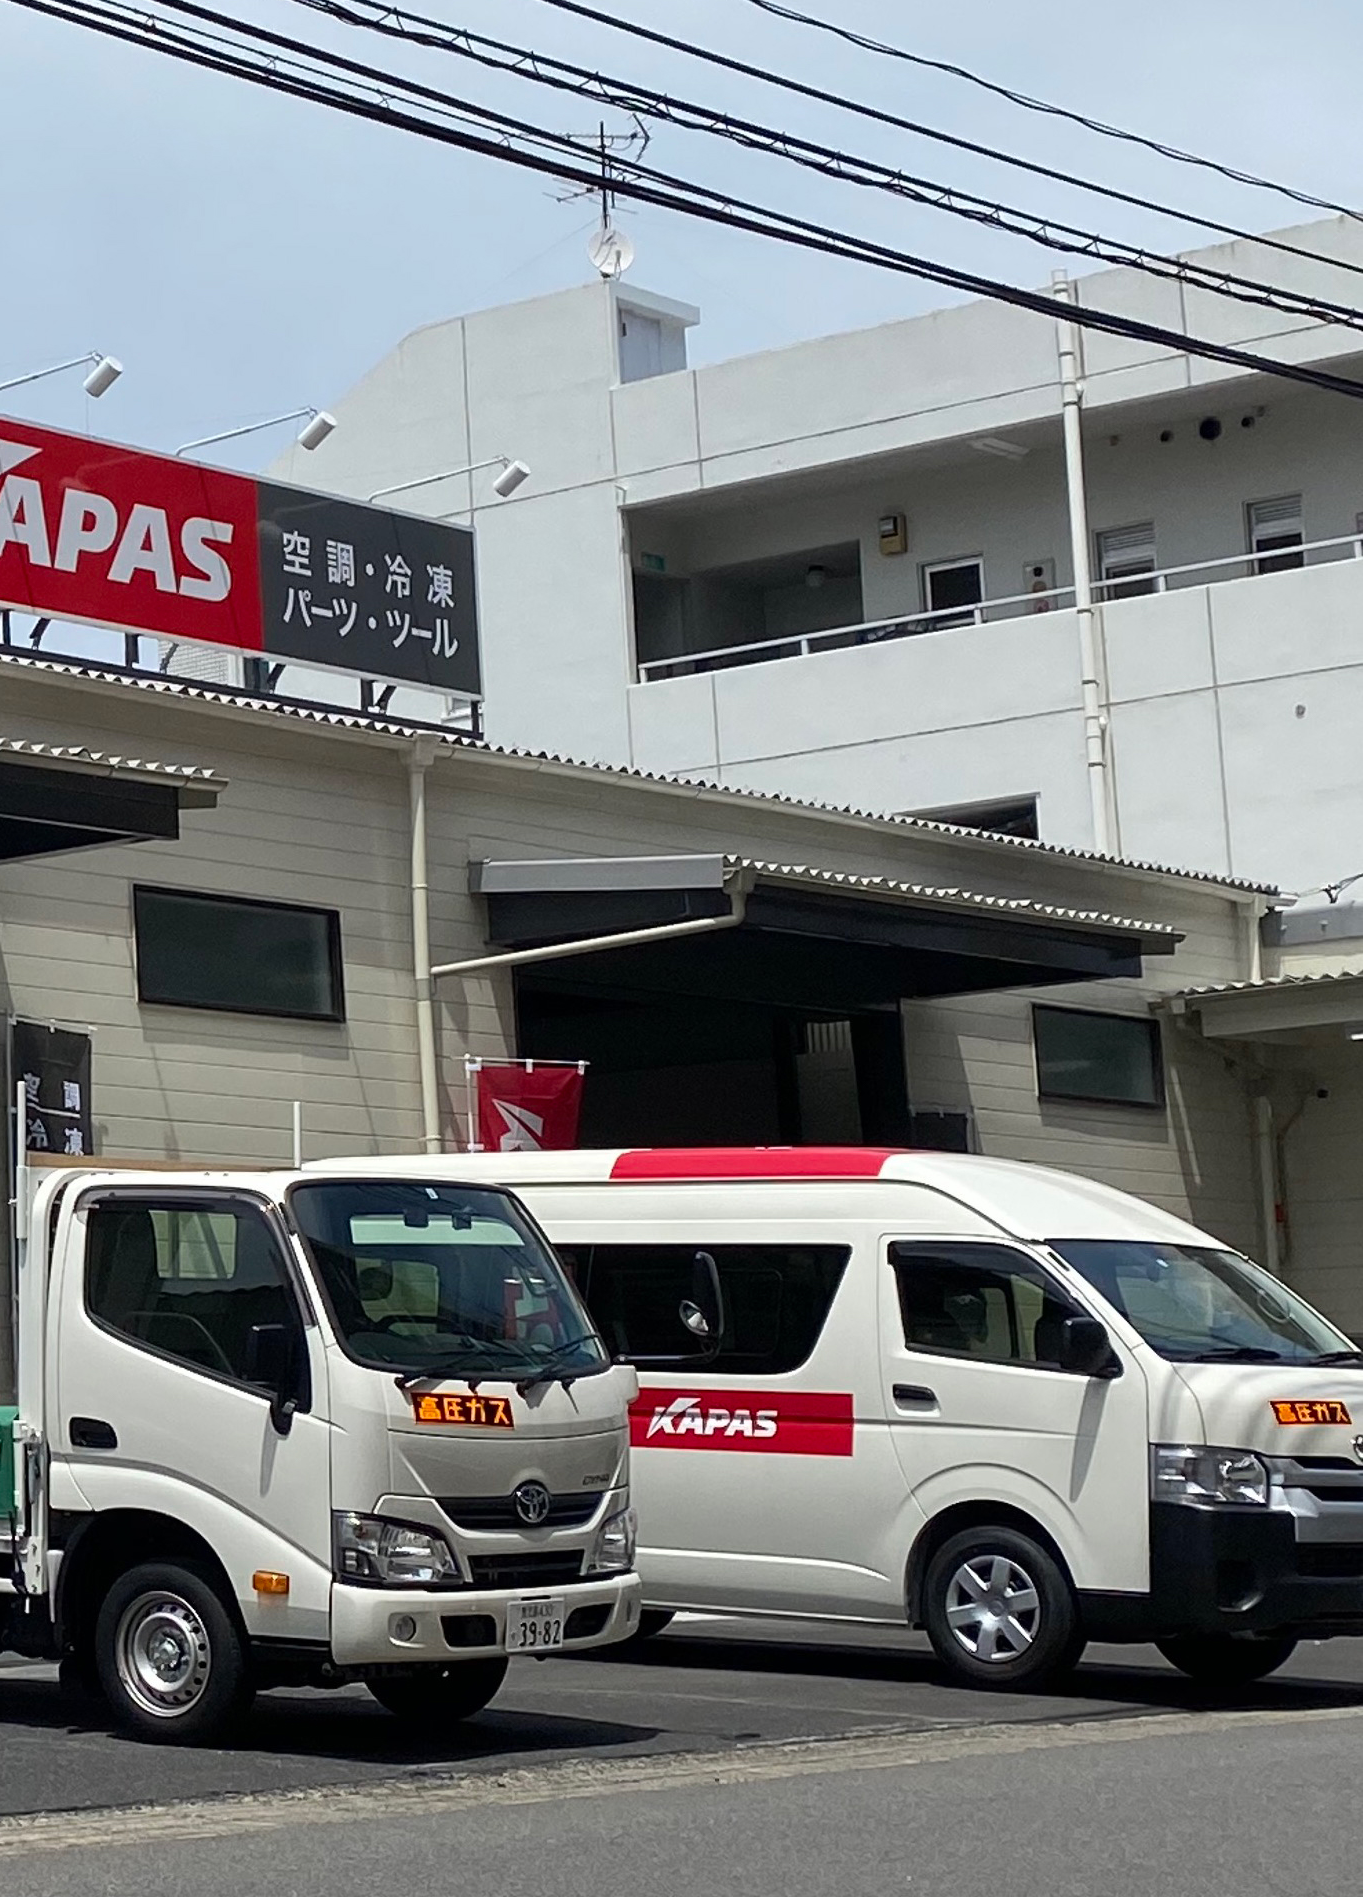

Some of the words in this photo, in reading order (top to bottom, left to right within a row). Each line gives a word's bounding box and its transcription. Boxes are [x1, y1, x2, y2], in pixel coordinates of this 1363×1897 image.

[282, 530, 455, 608] 空調・冷凍
[282, 588, 458, 660] パーツ・ツール
[418, 1395, 510, 1425] 高圧ガス
[646, 1397, 778, 1439] KAPAS
